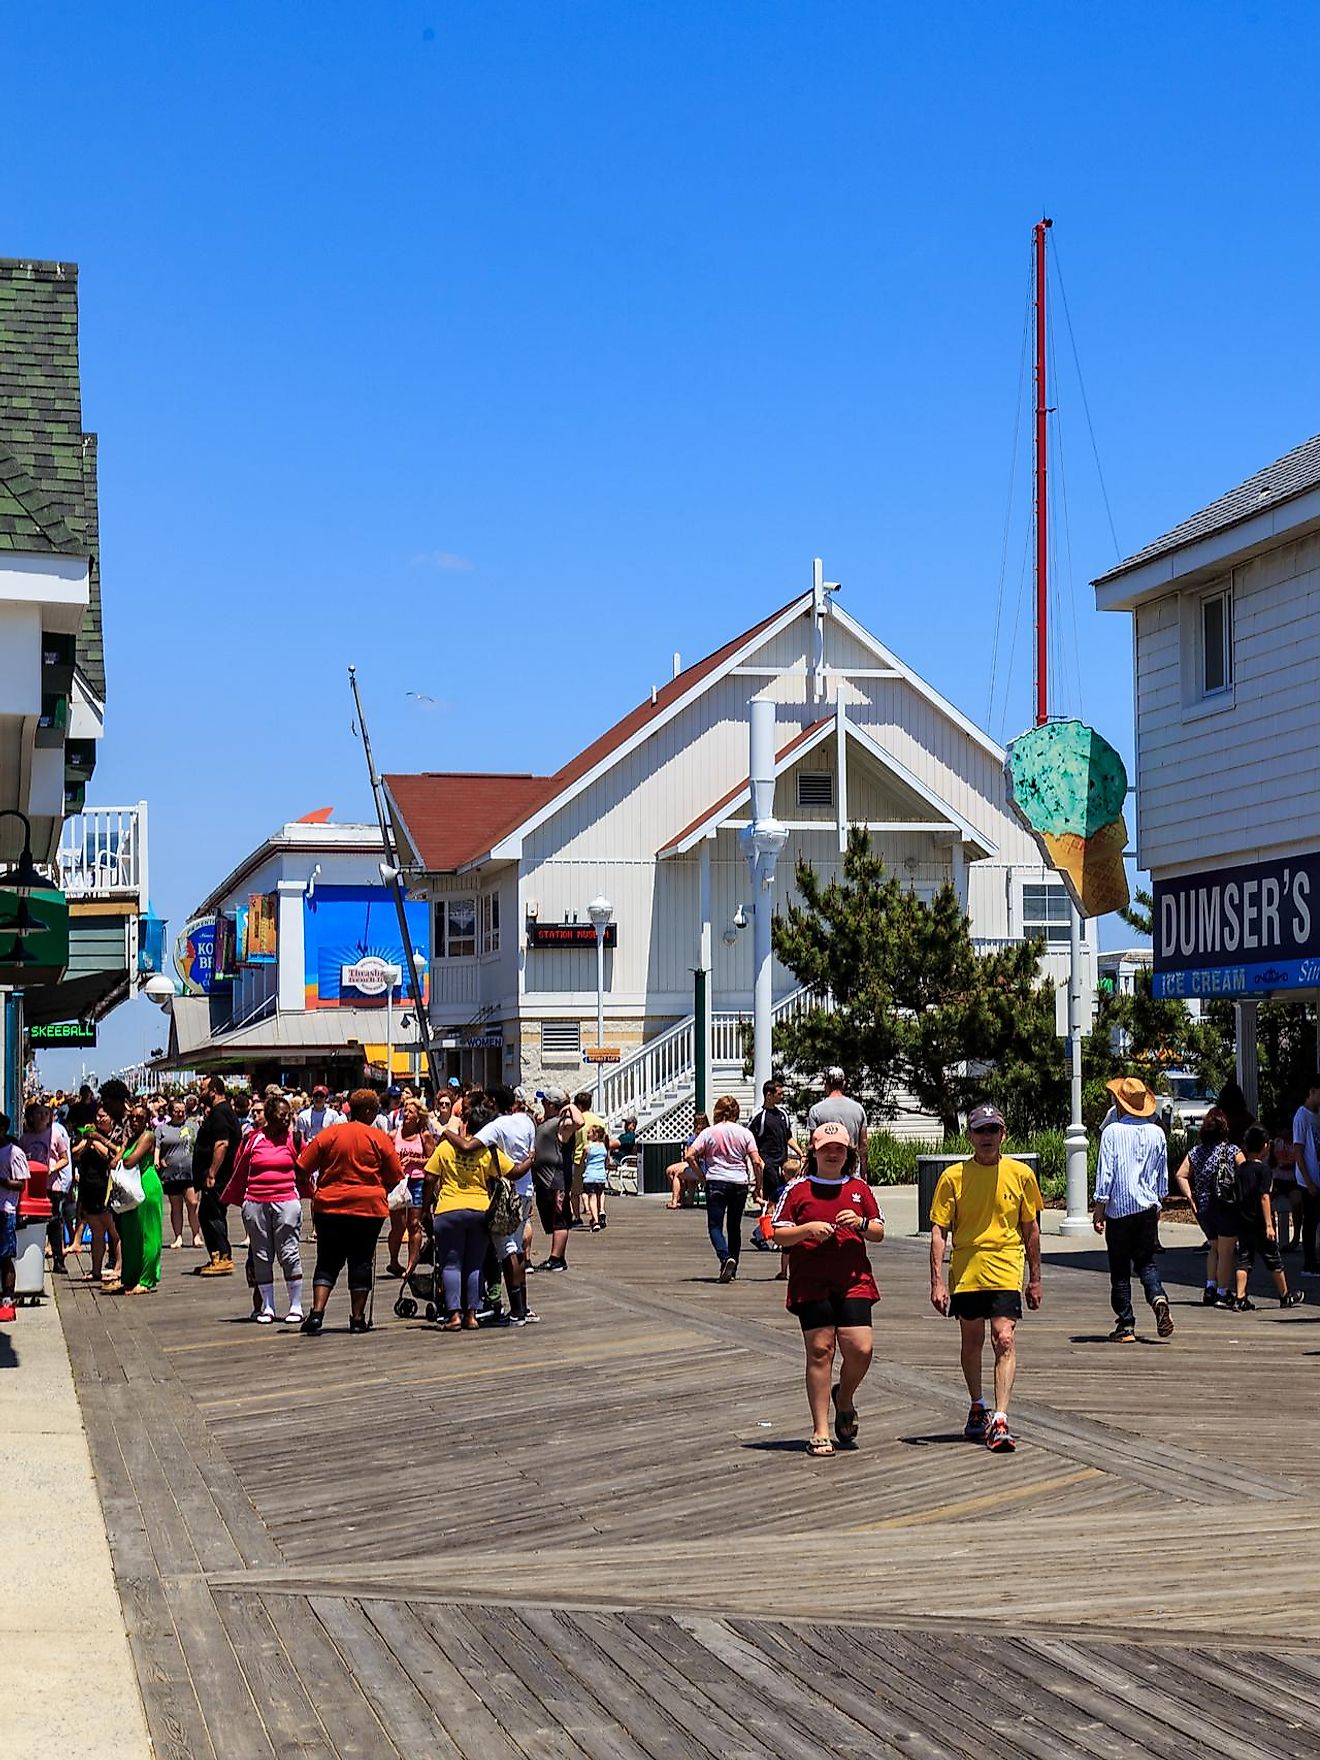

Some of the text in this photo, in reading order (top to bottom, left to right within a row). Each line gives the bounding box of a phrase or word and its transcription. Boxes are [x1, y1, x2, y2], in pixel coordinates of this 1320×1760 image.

[1161, 868, 1311, 957] DUMSER'S
[538, 930, 573, 939] STATION
[1161, 968, 1246, 995] ICE CREAM
[31, 1025, 94, 1037] SKEEBALL
[467, 1036, 503, 1048] WOMEN
